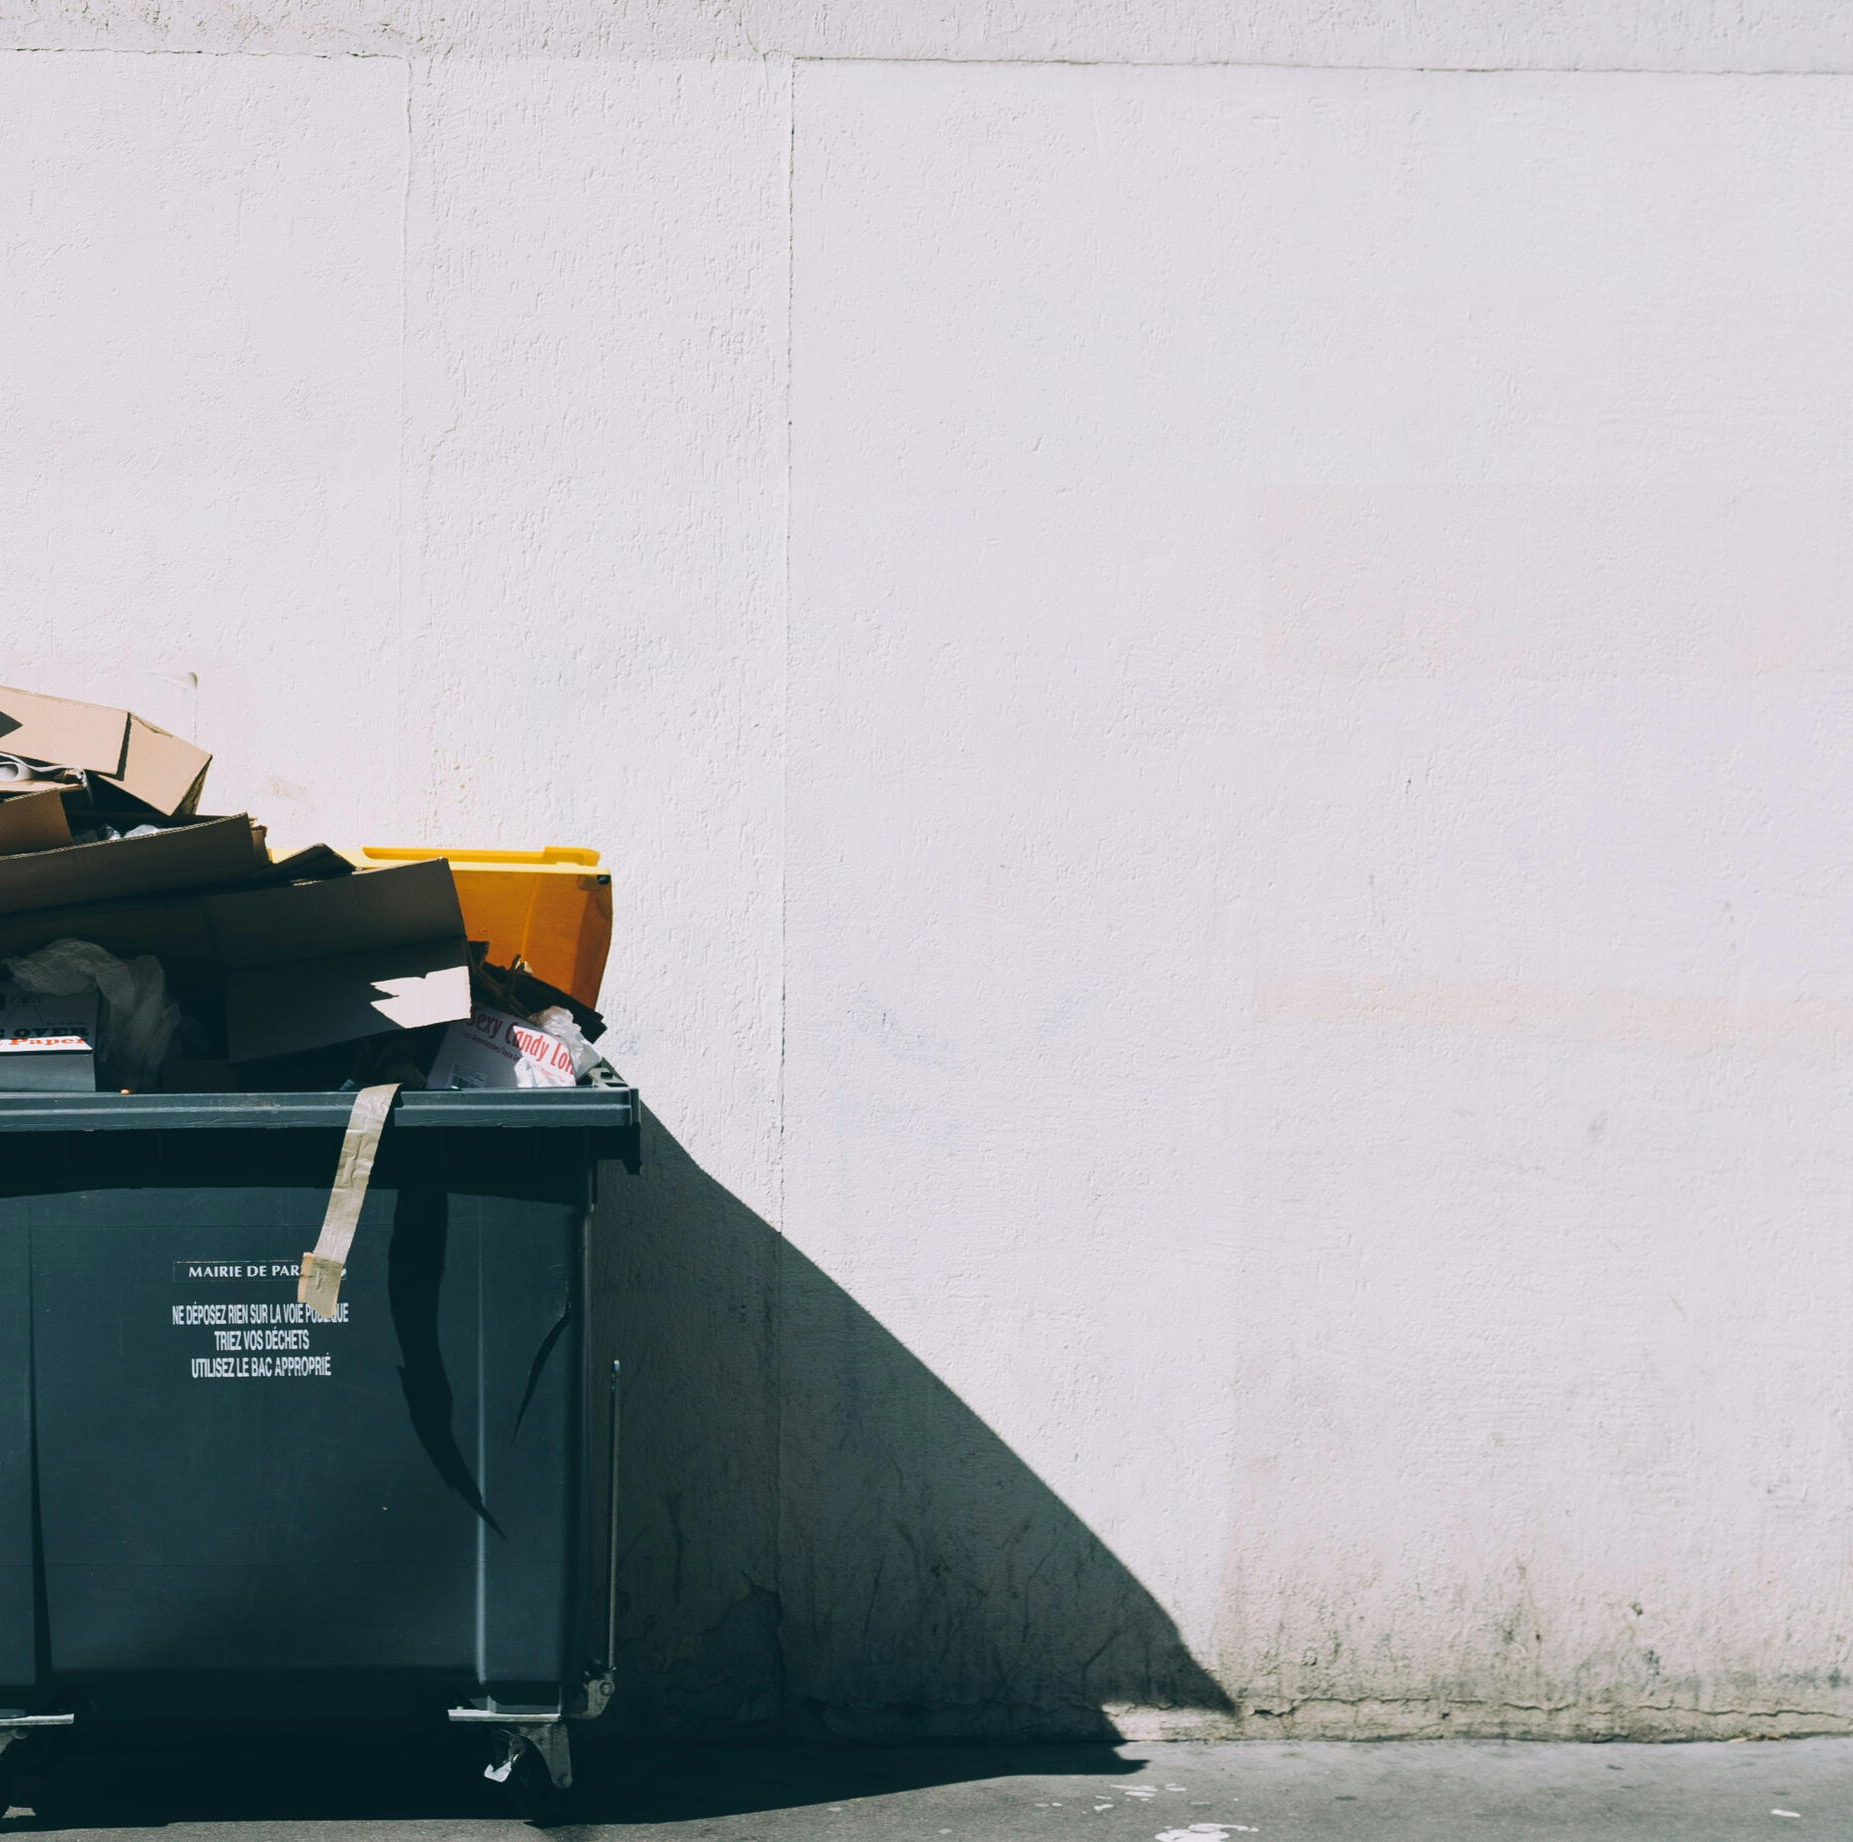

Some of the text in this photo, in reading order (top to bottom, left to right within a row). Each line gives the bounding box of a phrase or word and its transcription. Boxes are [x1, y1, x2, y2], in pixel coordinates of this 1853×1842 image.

[10, 1036, 88, 1046] Paper
[13, 1027, 90, 1038] OVER
[505, 1021, 550, 1062] Candy
[189, 1265, 301, 1278] MAIRIE DE PAR
[172, 1301, 349, 1325] NE DÉPOSEZ RIEN SUR LA VOIE PUUE
[214, 1327, 310, 1351] TRIEZ VOS DÉCHETS
[191, 1352, 332, 1379] UTILISEZ LE BAC APPROPRIÉ
